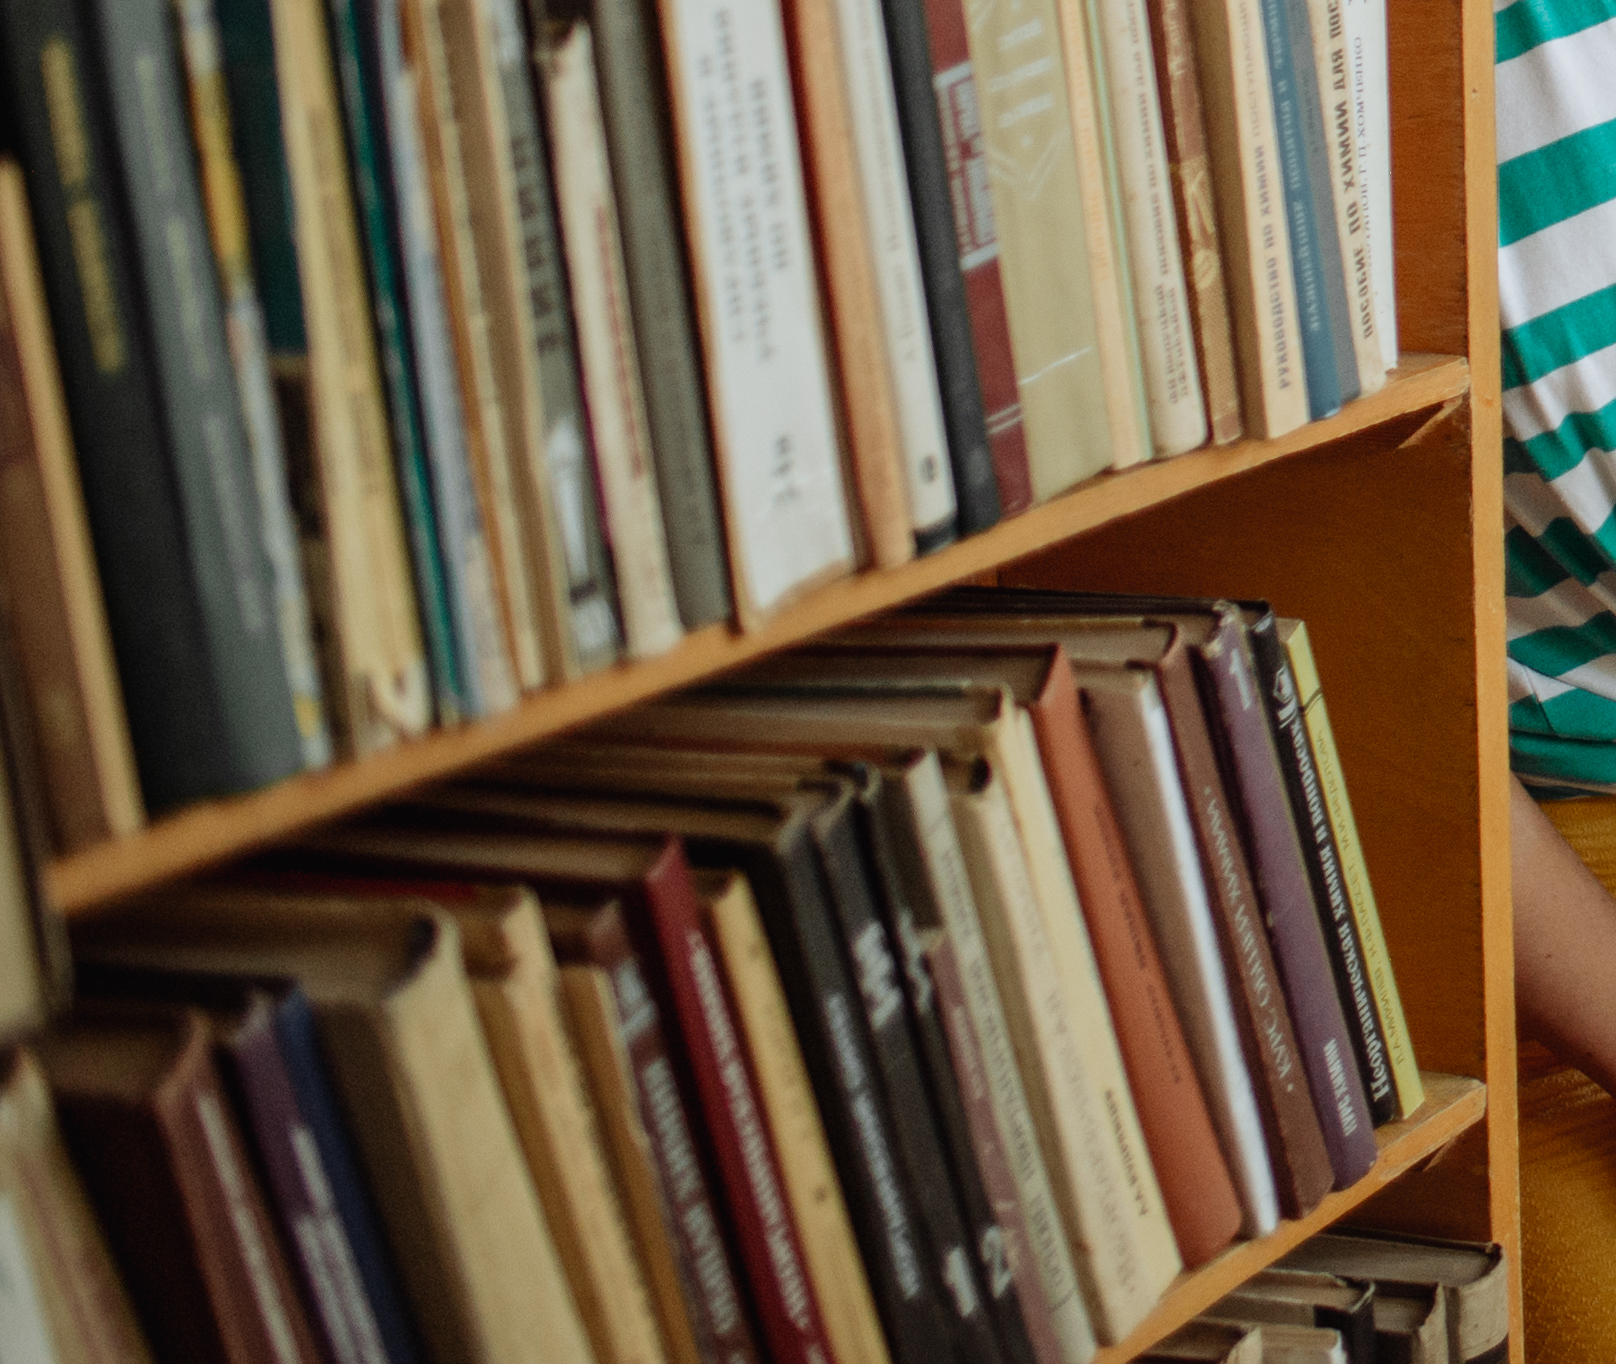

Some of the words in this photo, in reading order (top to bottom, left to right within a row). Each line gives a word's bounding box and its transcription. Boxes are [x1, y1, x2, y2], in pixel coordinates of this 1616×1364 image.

[1329, 46, 1346, 92] ДЛЯ
[1352, 34, 1367, 142] ХОМЧЕНКО
[1252, 144, 1272, 217] ХИМИИ
[1333, 98, 1356, 193] ХИМИИ
[1345, 199, 1361, 236] ПО
[1264, 255, 1292, 391] РУКОВОДСТВО
[1351, 246, 1374, 339] ПОСОБИЕ
[1229, 647, 1252, 712] 1
[1286, 717, 1325, 827] вопросах
[1317, 843, 1347, 922] химия
[1336, 920, 1392, 1103] Неорганическая
